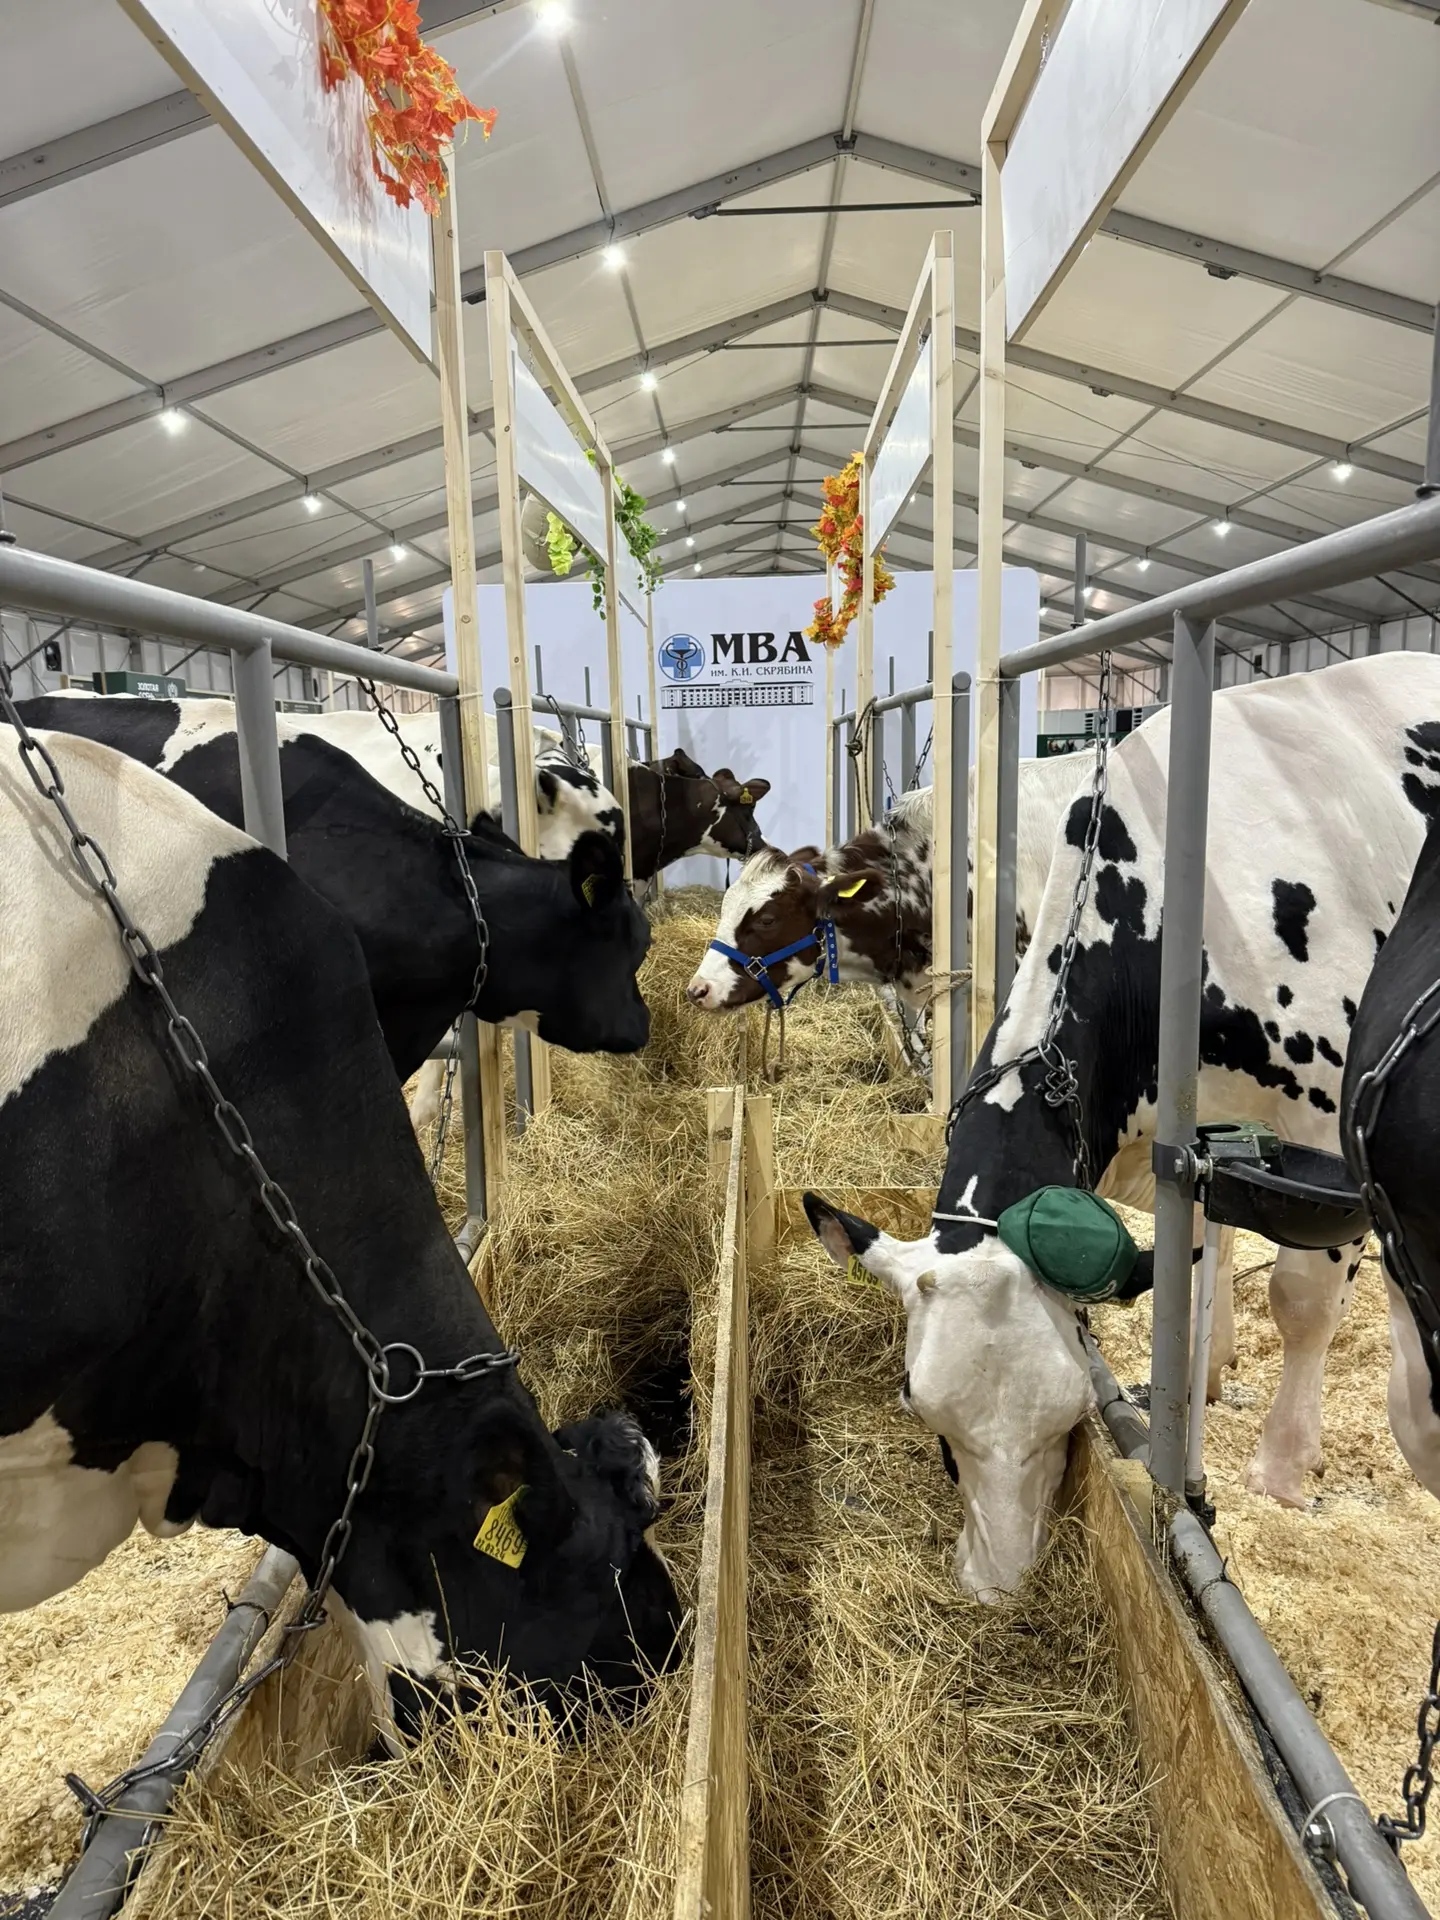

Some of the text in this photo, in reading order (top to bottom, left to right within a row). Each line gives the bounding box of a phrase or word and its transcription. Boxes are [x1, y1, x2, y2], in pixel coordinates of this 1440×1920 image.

[710, 631, 812, 665] МВА
[731, 667, 753, 677] К.И.
[755, 665, 813, 676] СКРЯБИНА
[137, 682, 160, 692] ЗОЛОТАЯ
[484, 1518, 524, 1555] 8469
